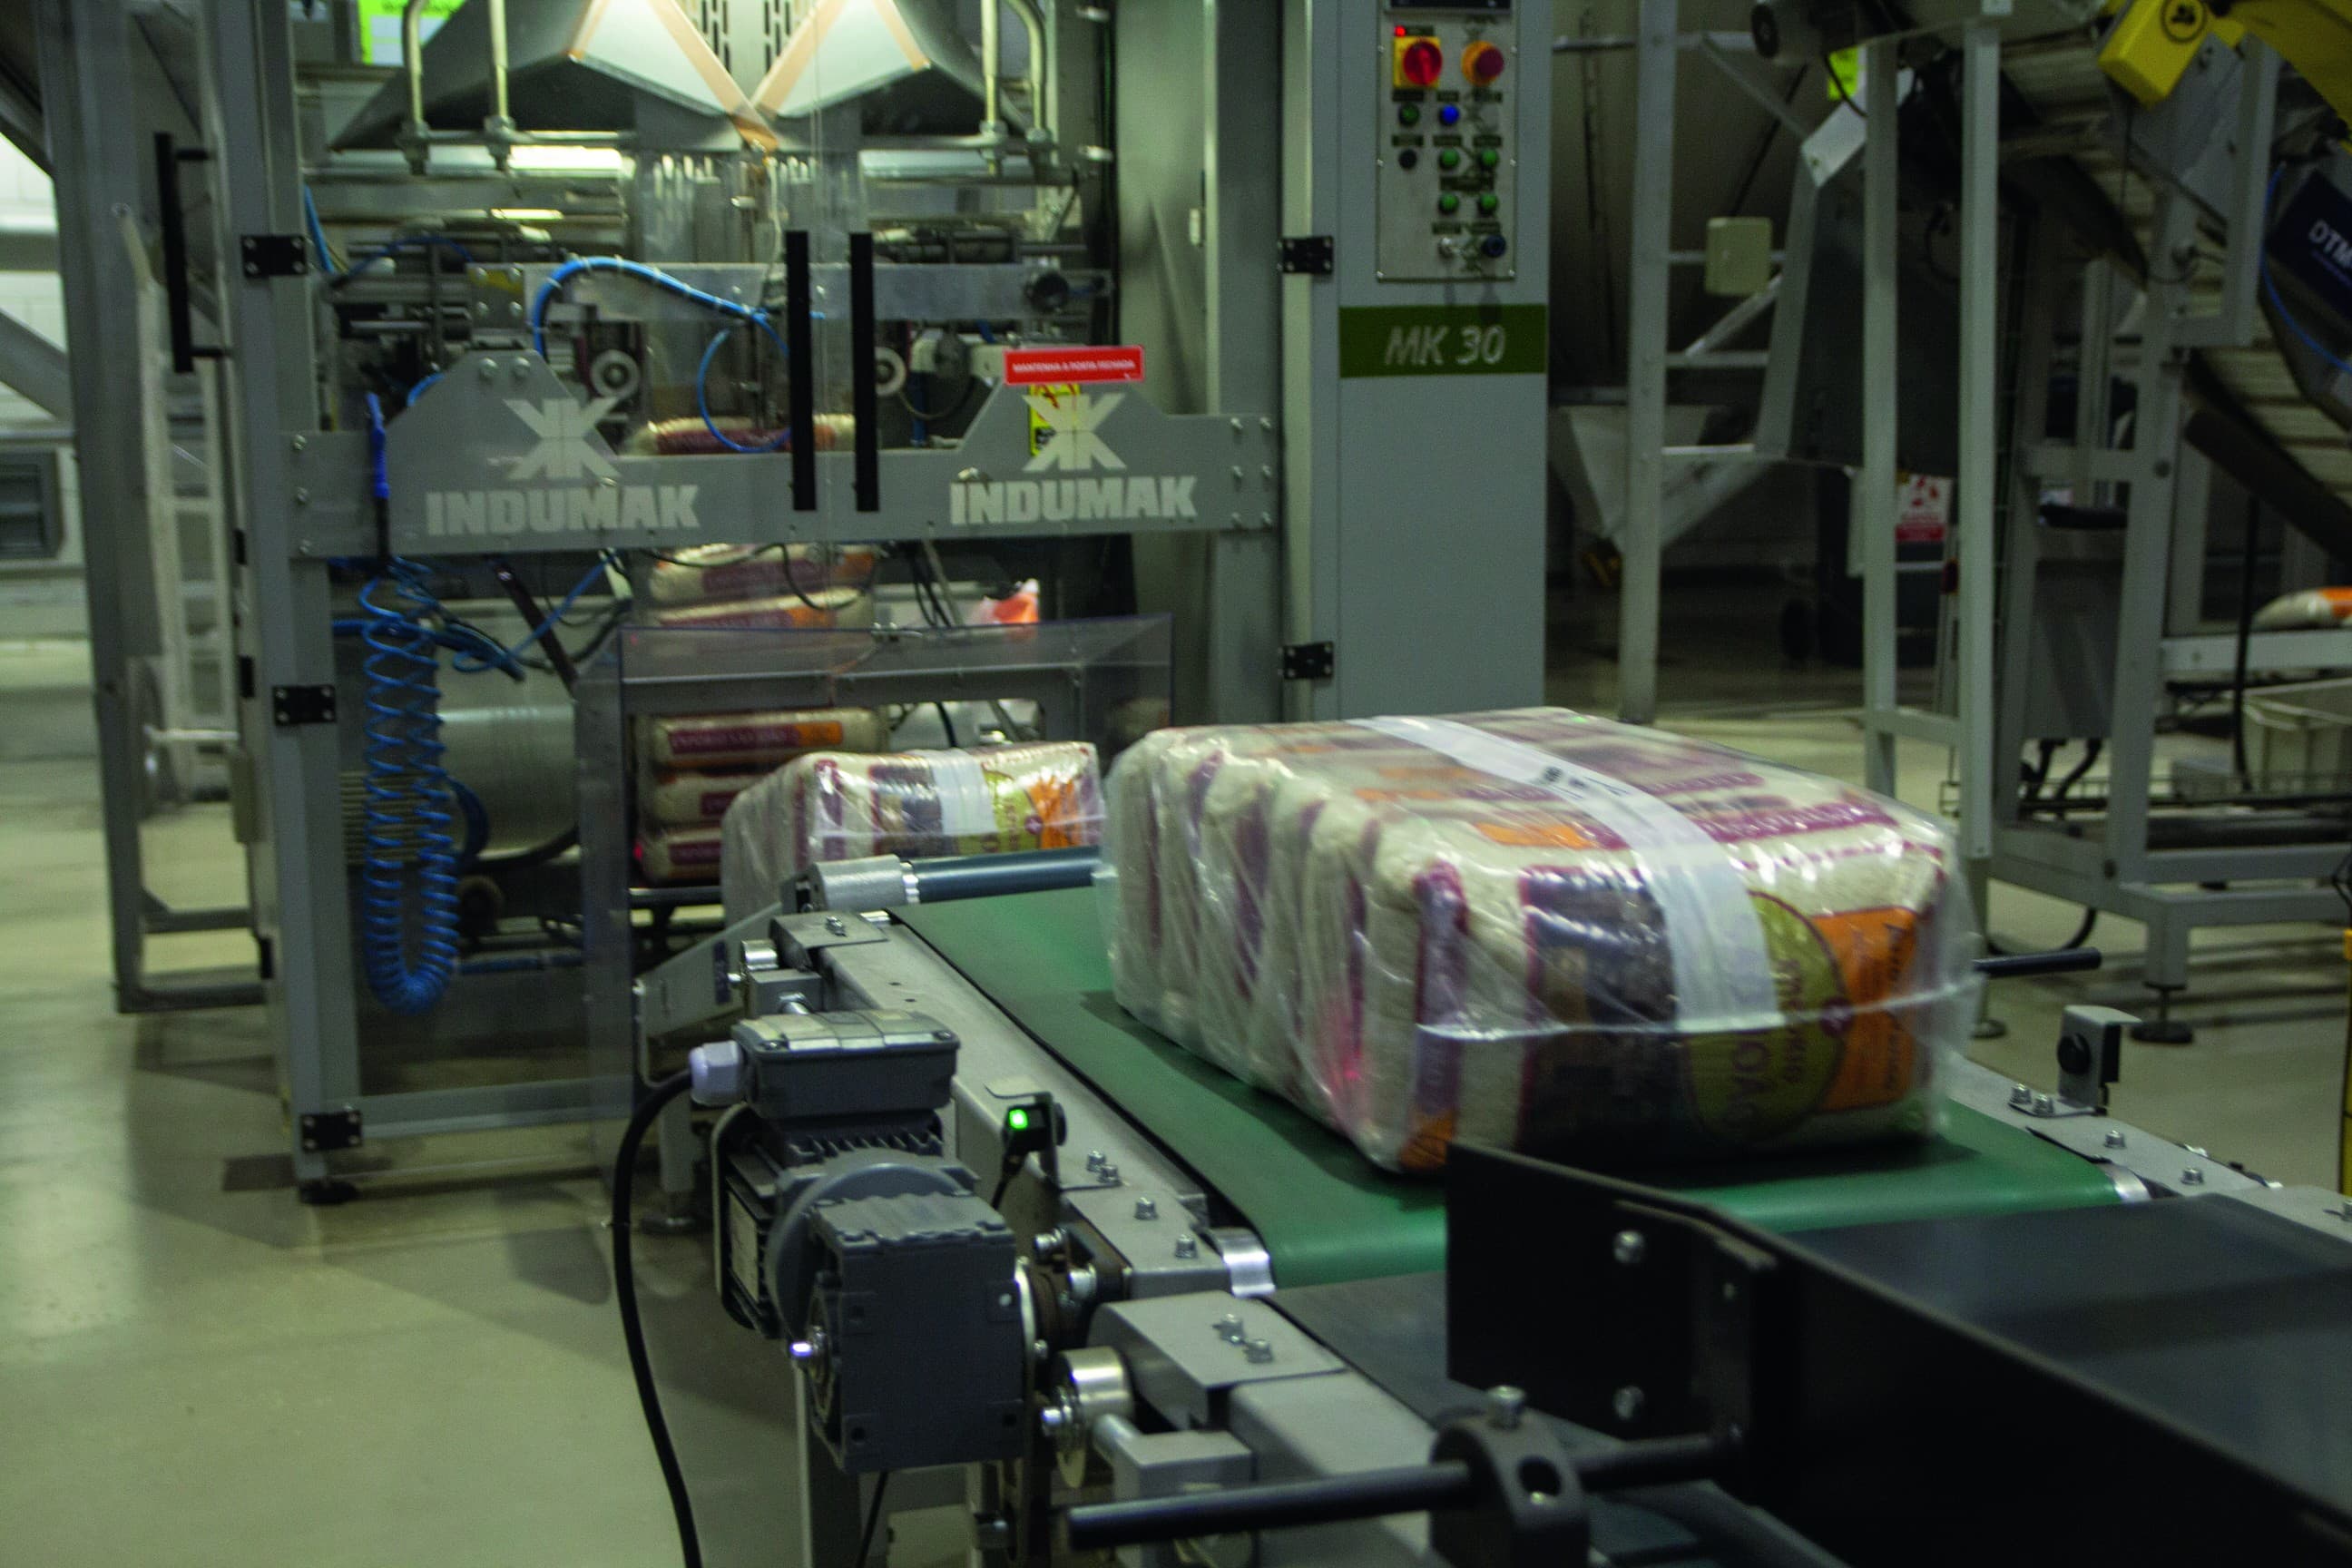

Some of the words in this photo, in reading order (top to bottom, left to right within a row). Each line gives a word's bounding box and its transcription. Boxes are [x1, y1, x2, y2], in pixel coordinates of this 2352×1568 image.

[1385, 325, 1449, 365] MK
[1455, 324, 1506, 365] 30
[426, 485, 701, 536] INDUMAK
[949, 475, 1198, 525] INDUMAK
